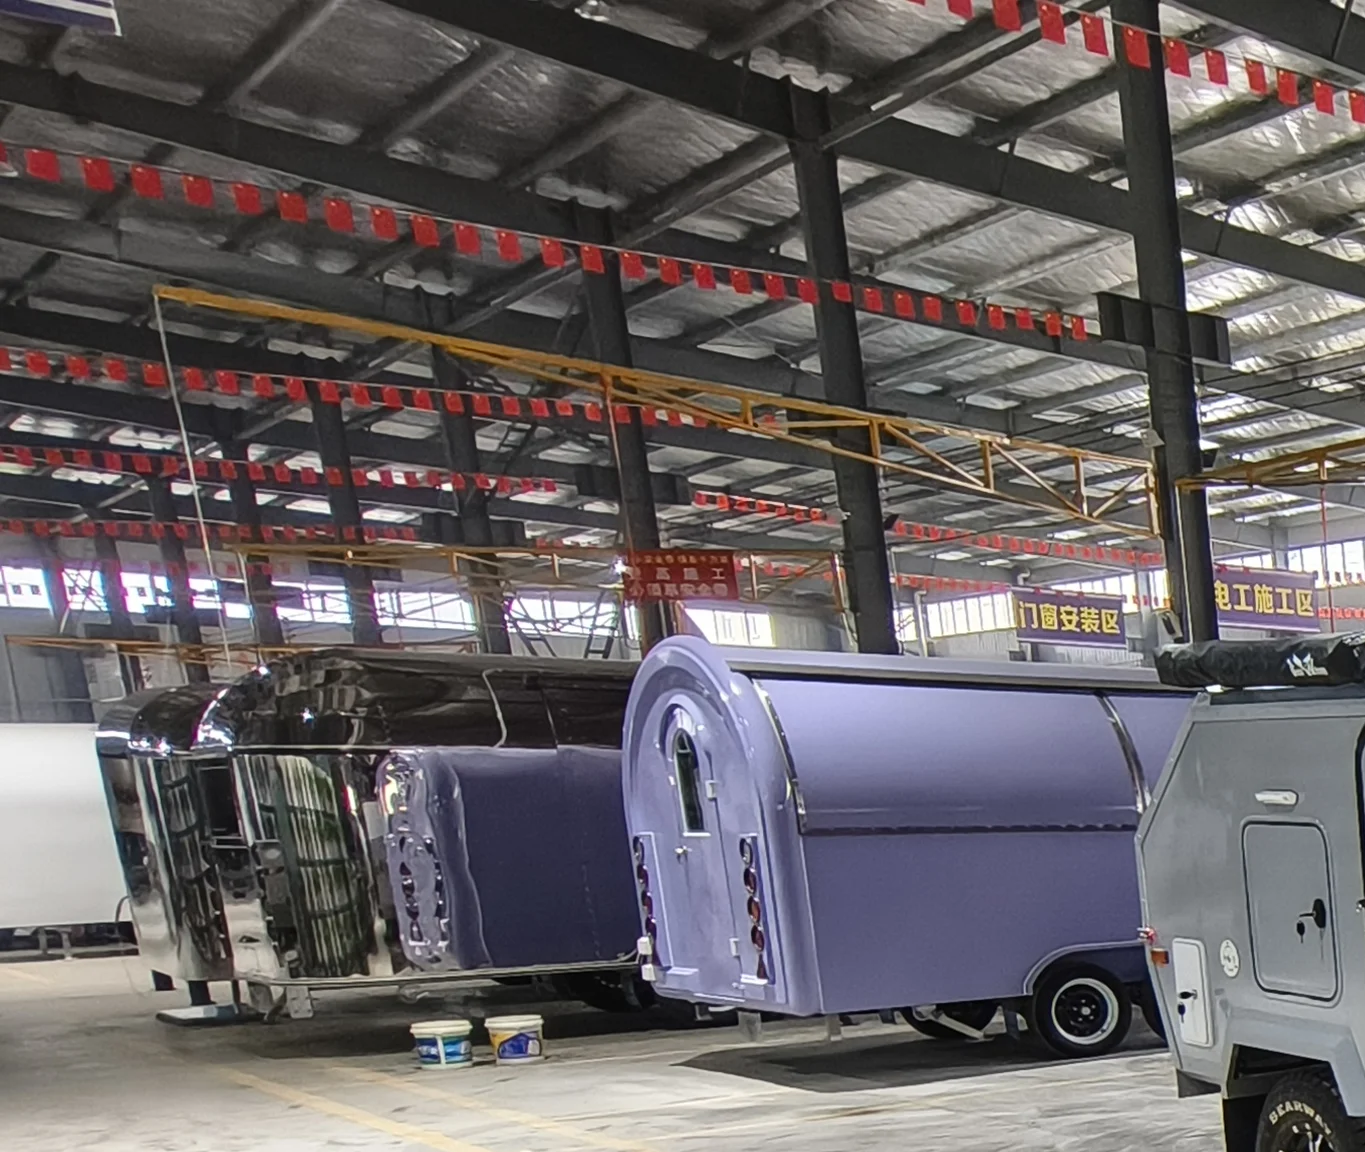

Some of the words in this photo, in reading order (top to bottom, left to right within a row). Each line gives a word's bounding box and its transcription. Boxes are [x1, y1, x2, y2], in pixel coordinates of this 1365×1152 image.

[1018, 600, 1121, 635] 门窗安装区
